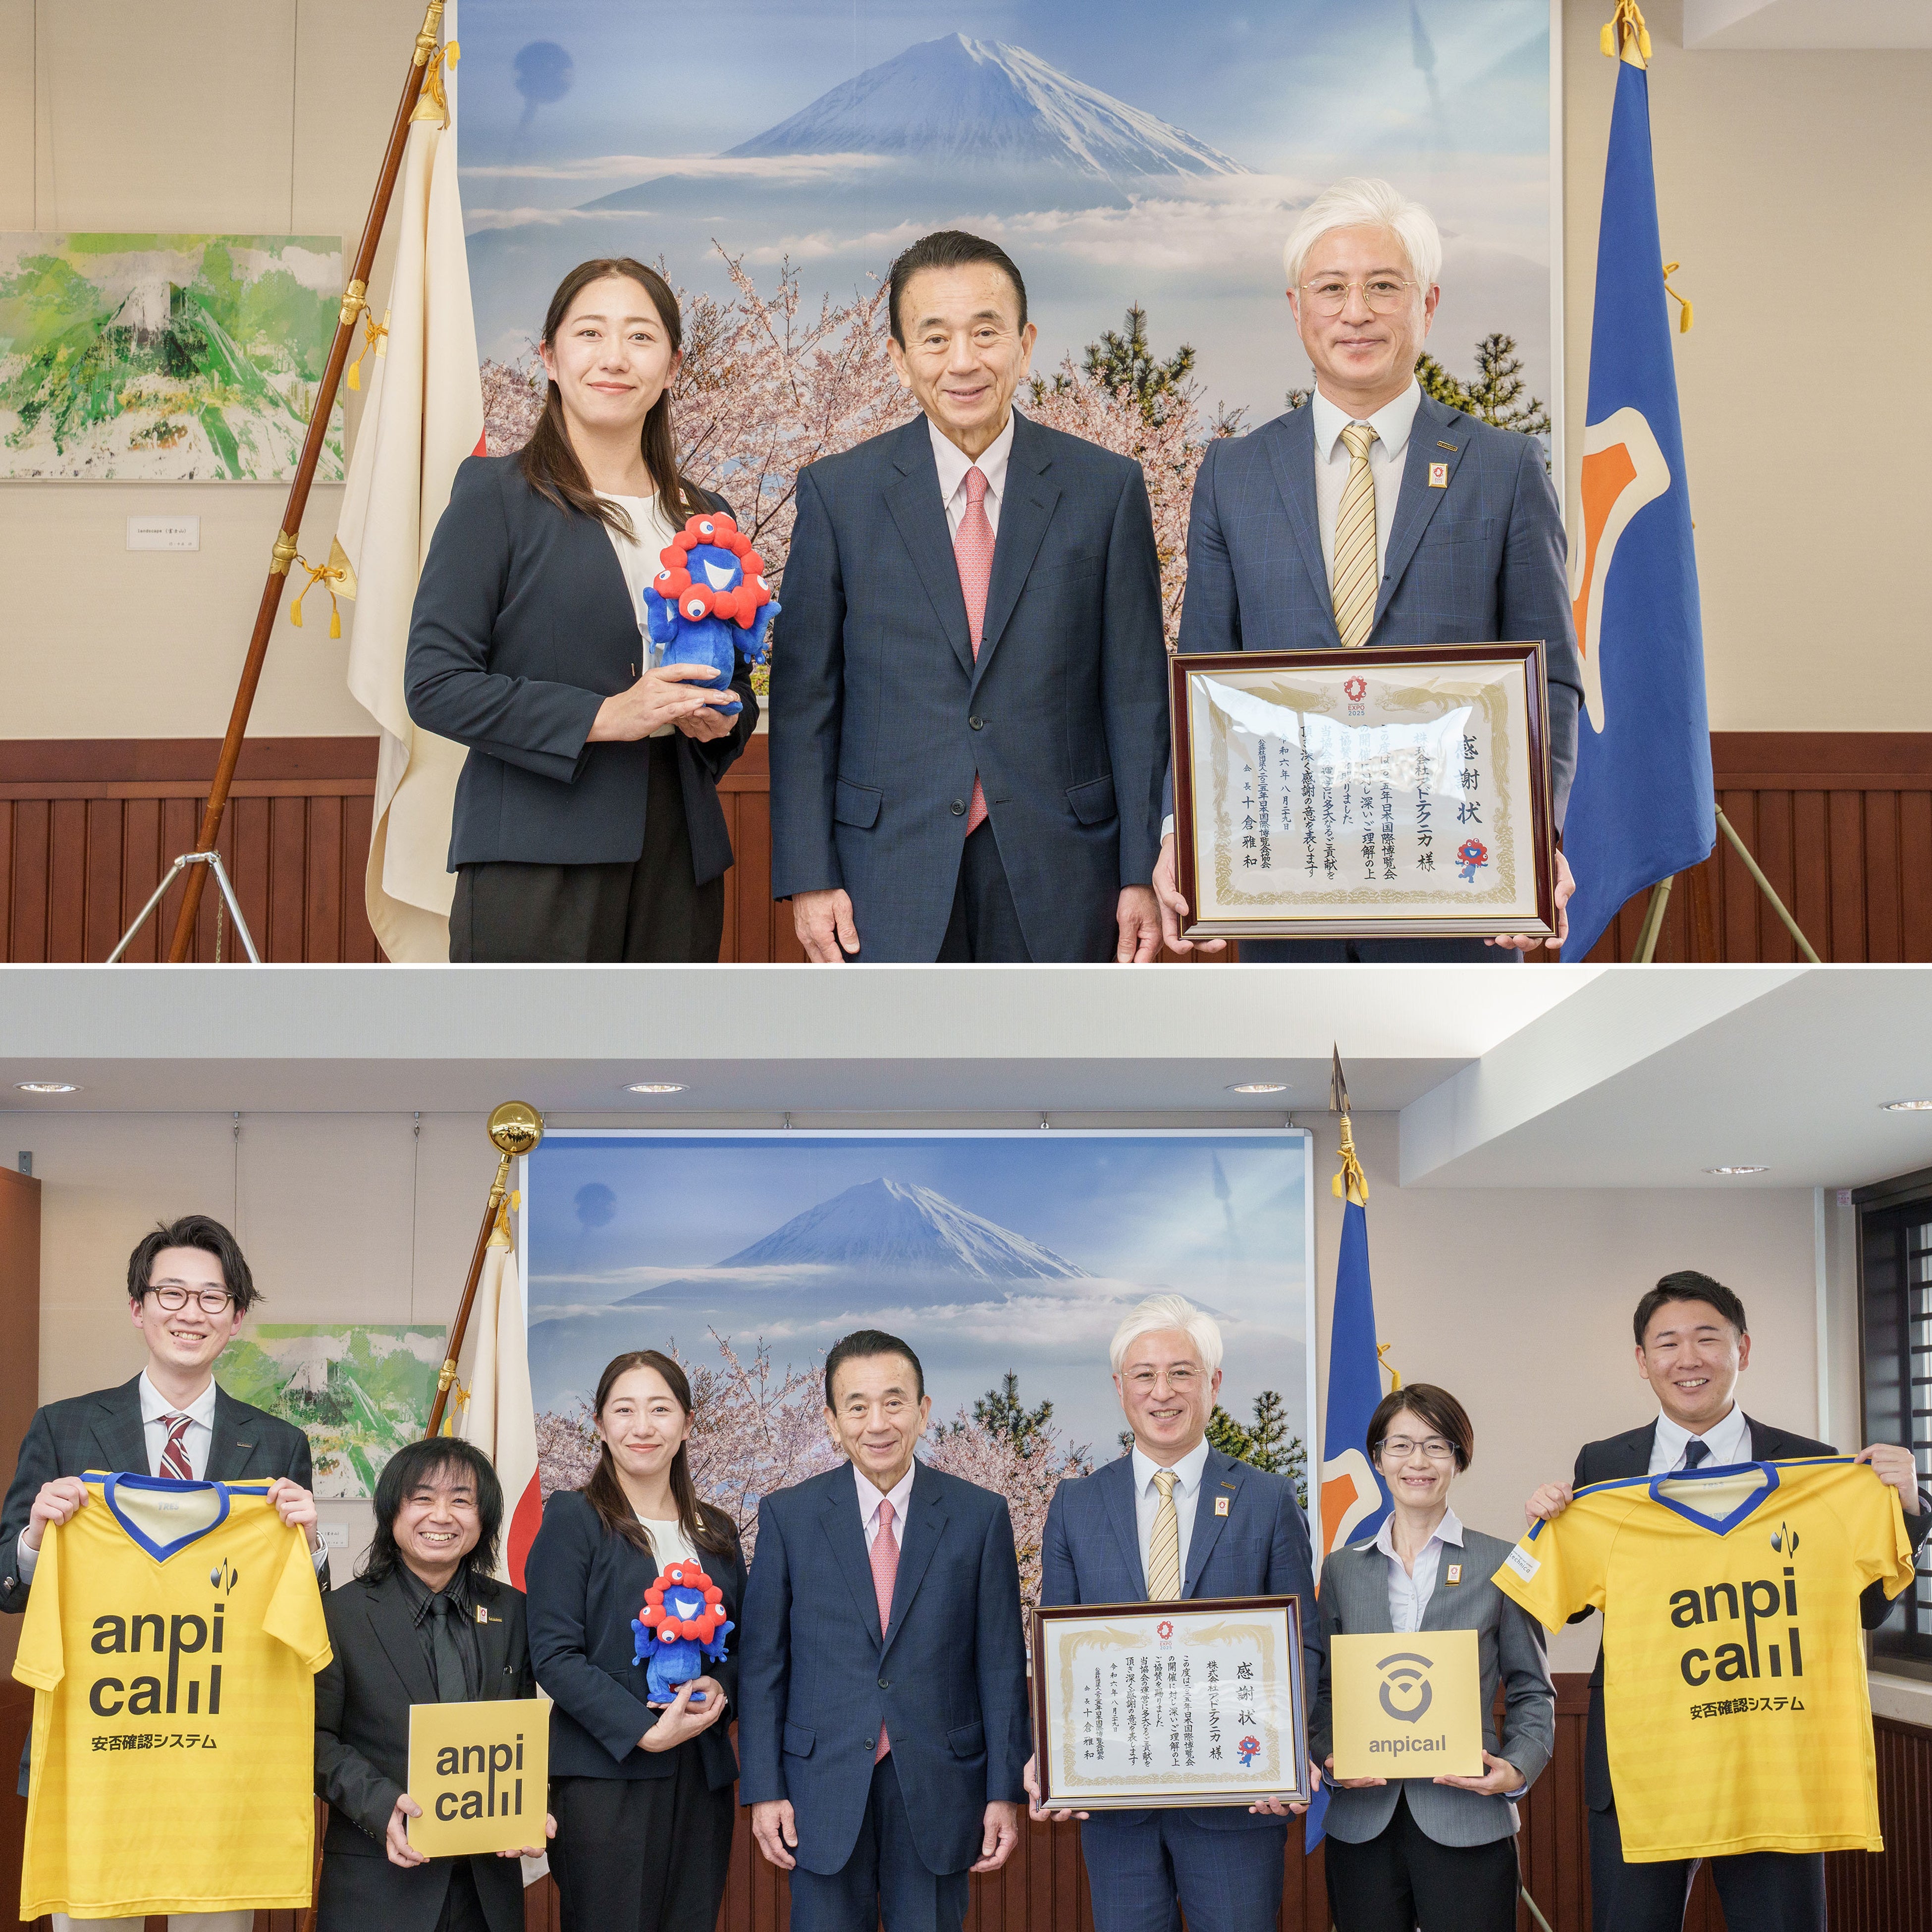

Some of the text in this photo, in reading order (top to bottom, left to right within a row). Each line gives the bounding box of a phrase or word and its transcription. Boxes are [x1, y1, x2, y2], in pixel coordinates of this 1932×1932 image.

[1454, 734, 1483, 824] 感謝状
[1509, 1553, 1531, 1573] technica
[1236, 1661, 1257, 1726] 感謝状
[1690, 1696, 1805, 1720] 安否確認システム
[92, 1734, 217, 1751] 安否確認システム
